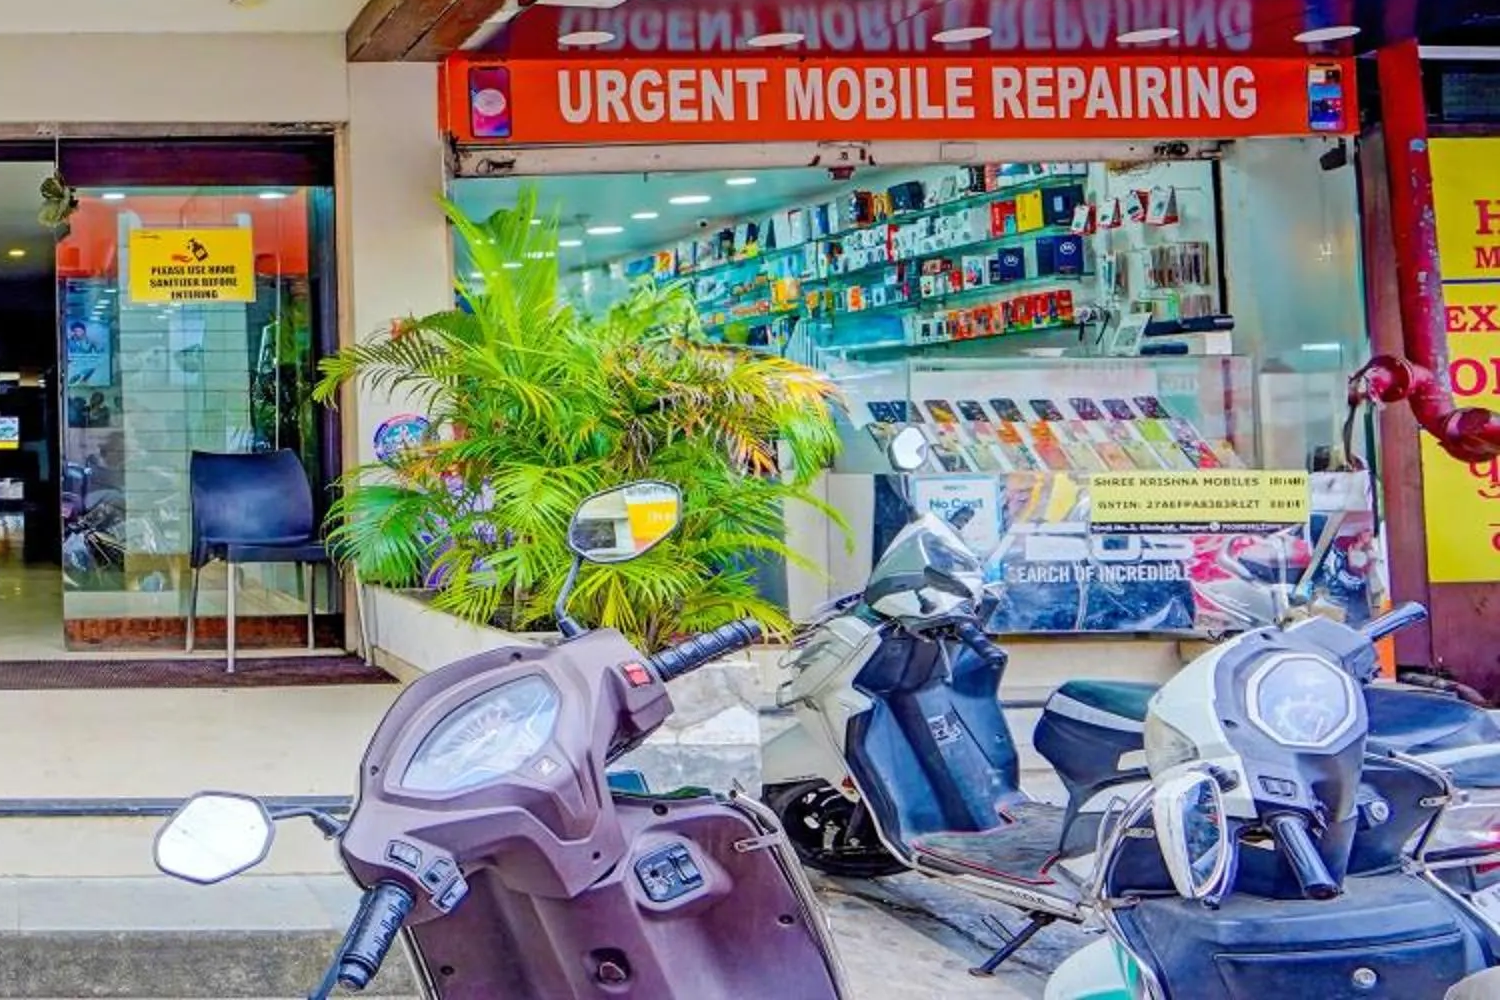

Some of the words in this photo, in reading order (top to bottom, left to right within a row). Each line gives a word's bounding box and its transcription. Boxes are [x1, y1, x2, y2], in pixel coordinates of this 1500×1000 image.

[558, 69, 767, 123] URGENT
[785, 67, 974, 121] MOBILE
[991, 66, 1258, 120] REPAIRING
[1094, 477, 1135, 487] SHREE
[1139, 477, 1199, 487] KRISHNA
[1203, 477, 1260, 487] MOBILES
[930, 498, 948, 510] No
[1007, 564, 1070, 583] SEARCH
[1074, 564, 1094, 583] OF
[1099, 562, 1191, 582] INCREDIBLE
